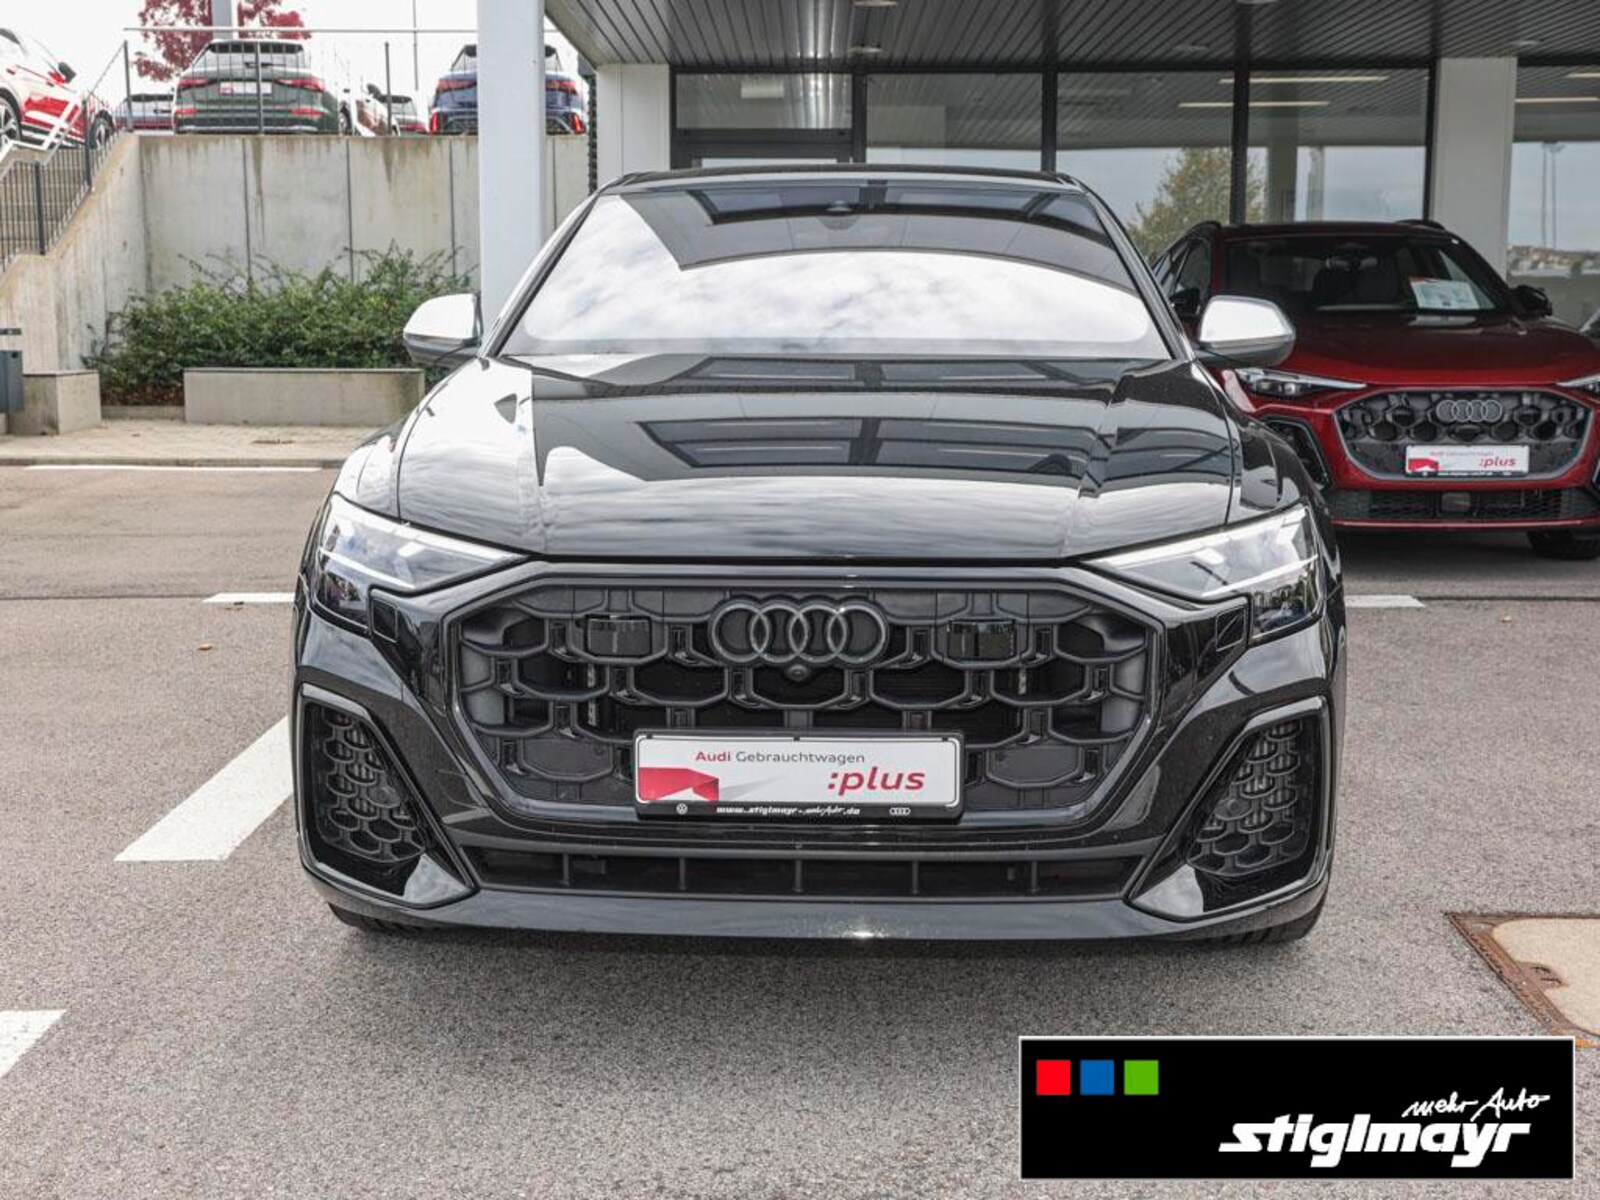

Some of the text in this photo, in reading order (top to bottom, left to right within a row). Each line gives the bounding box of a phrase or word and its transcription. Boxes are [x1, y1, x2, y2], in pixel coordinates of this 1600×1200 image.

[695, 751, 865, 765] Audi Gebrauchtwagen
[827, 767, 926, 796] :plus
